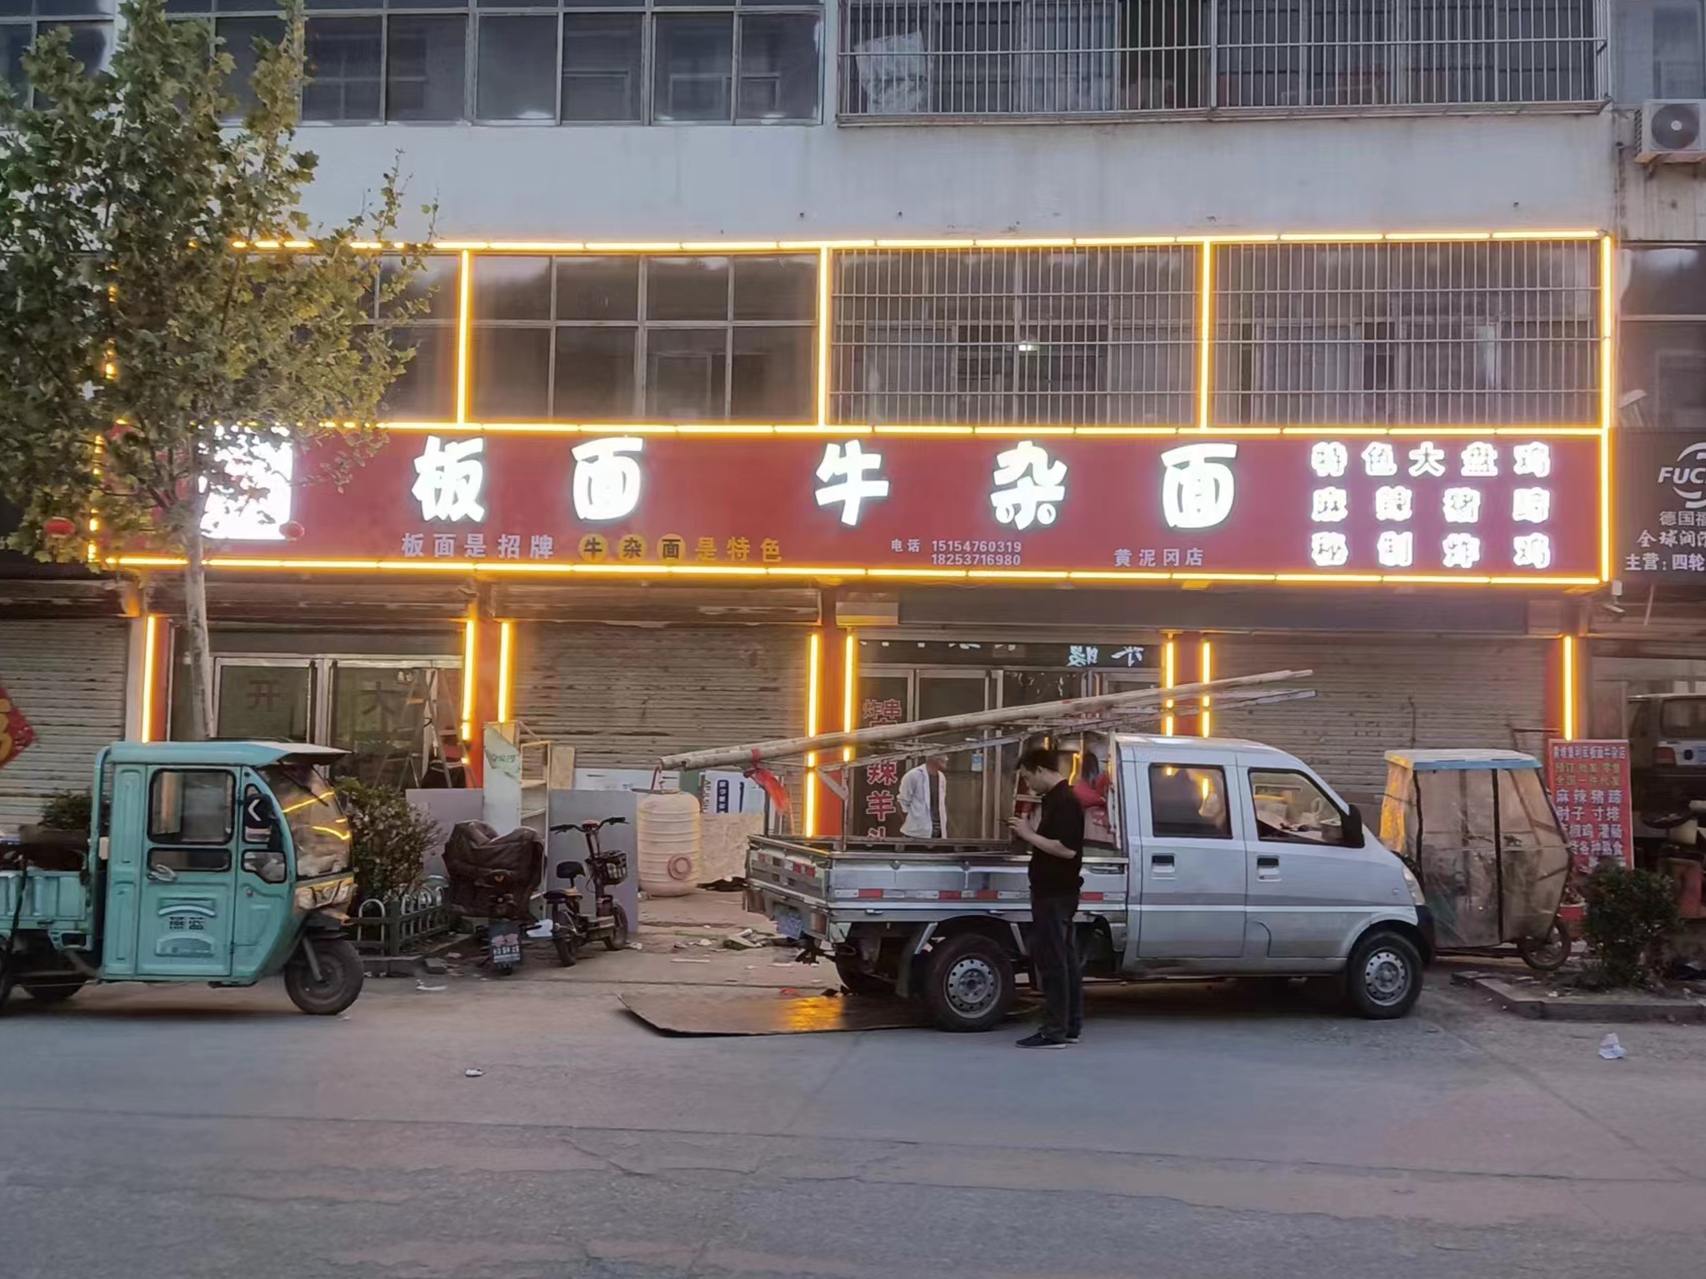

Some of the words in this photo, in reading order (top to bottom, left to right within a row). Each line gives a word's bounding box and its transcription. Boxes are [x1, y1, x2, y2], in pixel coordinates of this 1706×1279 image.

[412, 436, 644, 521] 板面
[815, 440, 1237, 530] 牛杂面
[1658, 466, 1706, 484] FUC
[401, 532, 554, 558] 板面是招牌
[583, 536, 782, 562] 牛杂面是特色
[891, 539, 921, 553] 电话
[931, 540, 1022, 552] 15154760319
[931, 553, 1021, 566] 18253716980
[1113, 547, 1204, 567] 黄泥冈店
[862, 699, 901, 719] 炸串
[1556, 789, 1622, 804] 麻辣猪蹄
